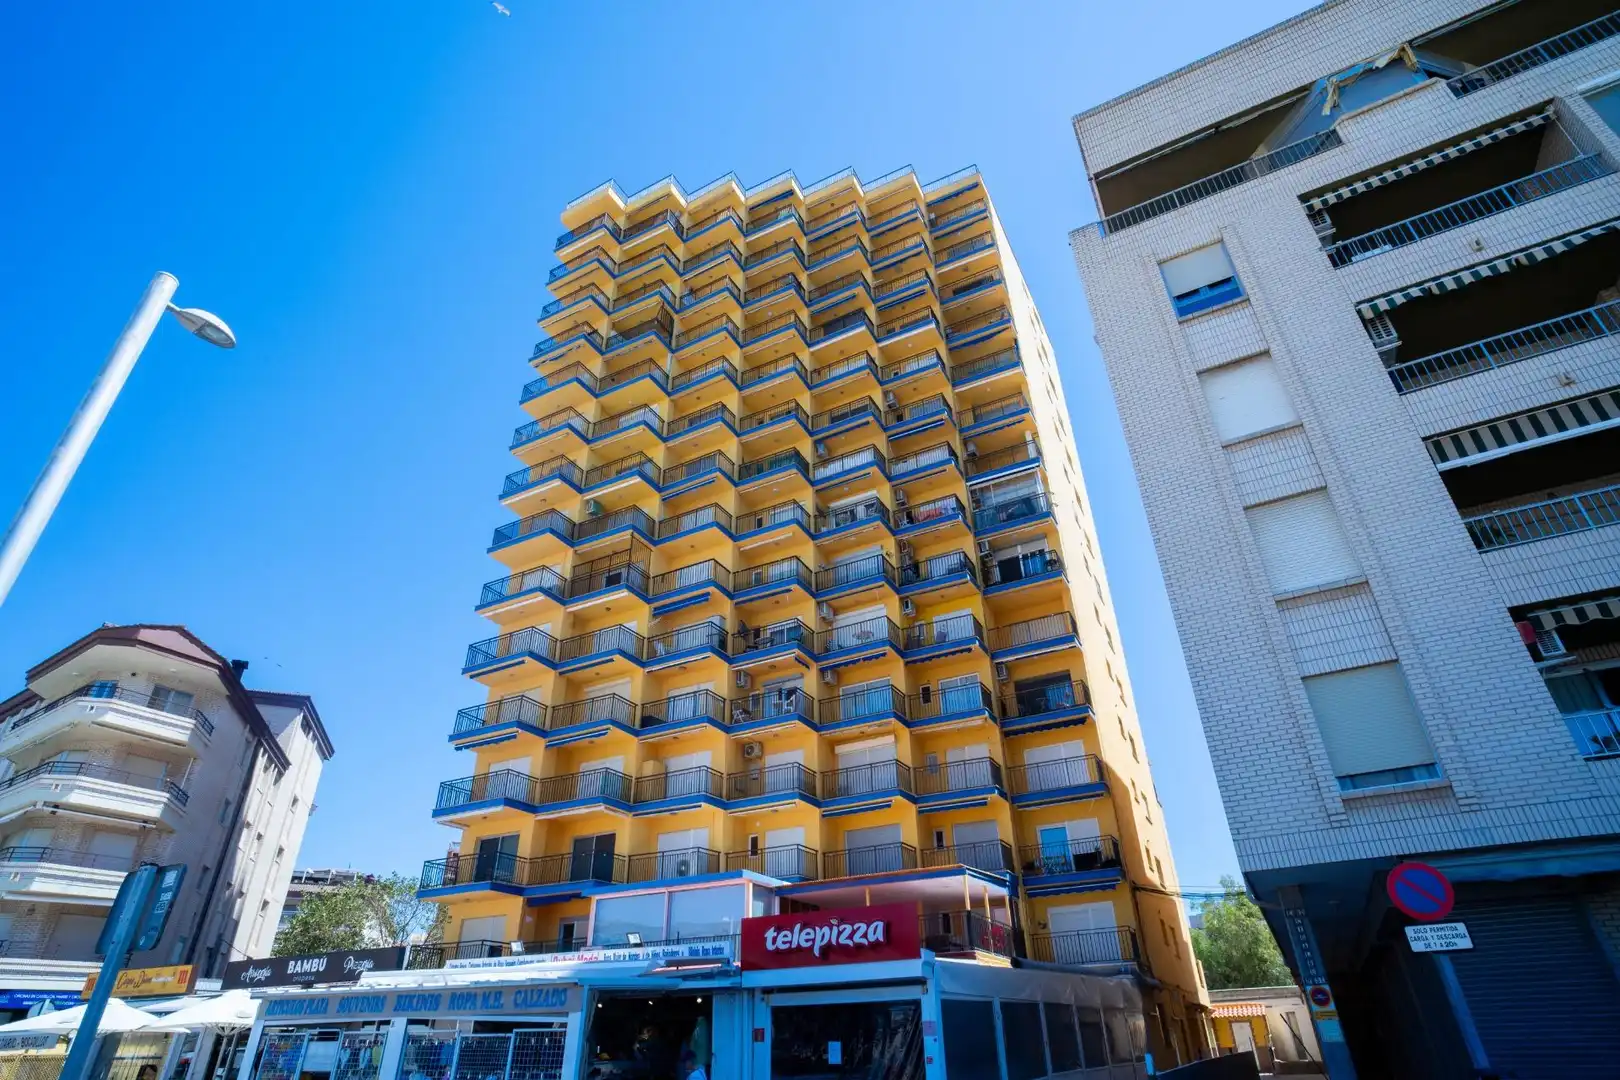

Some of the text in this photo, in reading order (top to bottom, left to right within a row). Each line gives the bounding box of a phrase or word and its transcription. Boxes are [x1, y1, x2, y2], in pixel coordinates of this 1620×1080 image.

[764, 918, 884, 957] telepizza
[1409, 934, 1429, 942] CARGA
[1436, 932, 1468, 941] DESCARGA
[1412, 925, 1459, 935] SOLO PERMITIDA
[287, 955, 328, 974] BAMBÚ
[448, 991, 478, 1010] ROPA
[513, 987, 568, 1009] CALZADO
